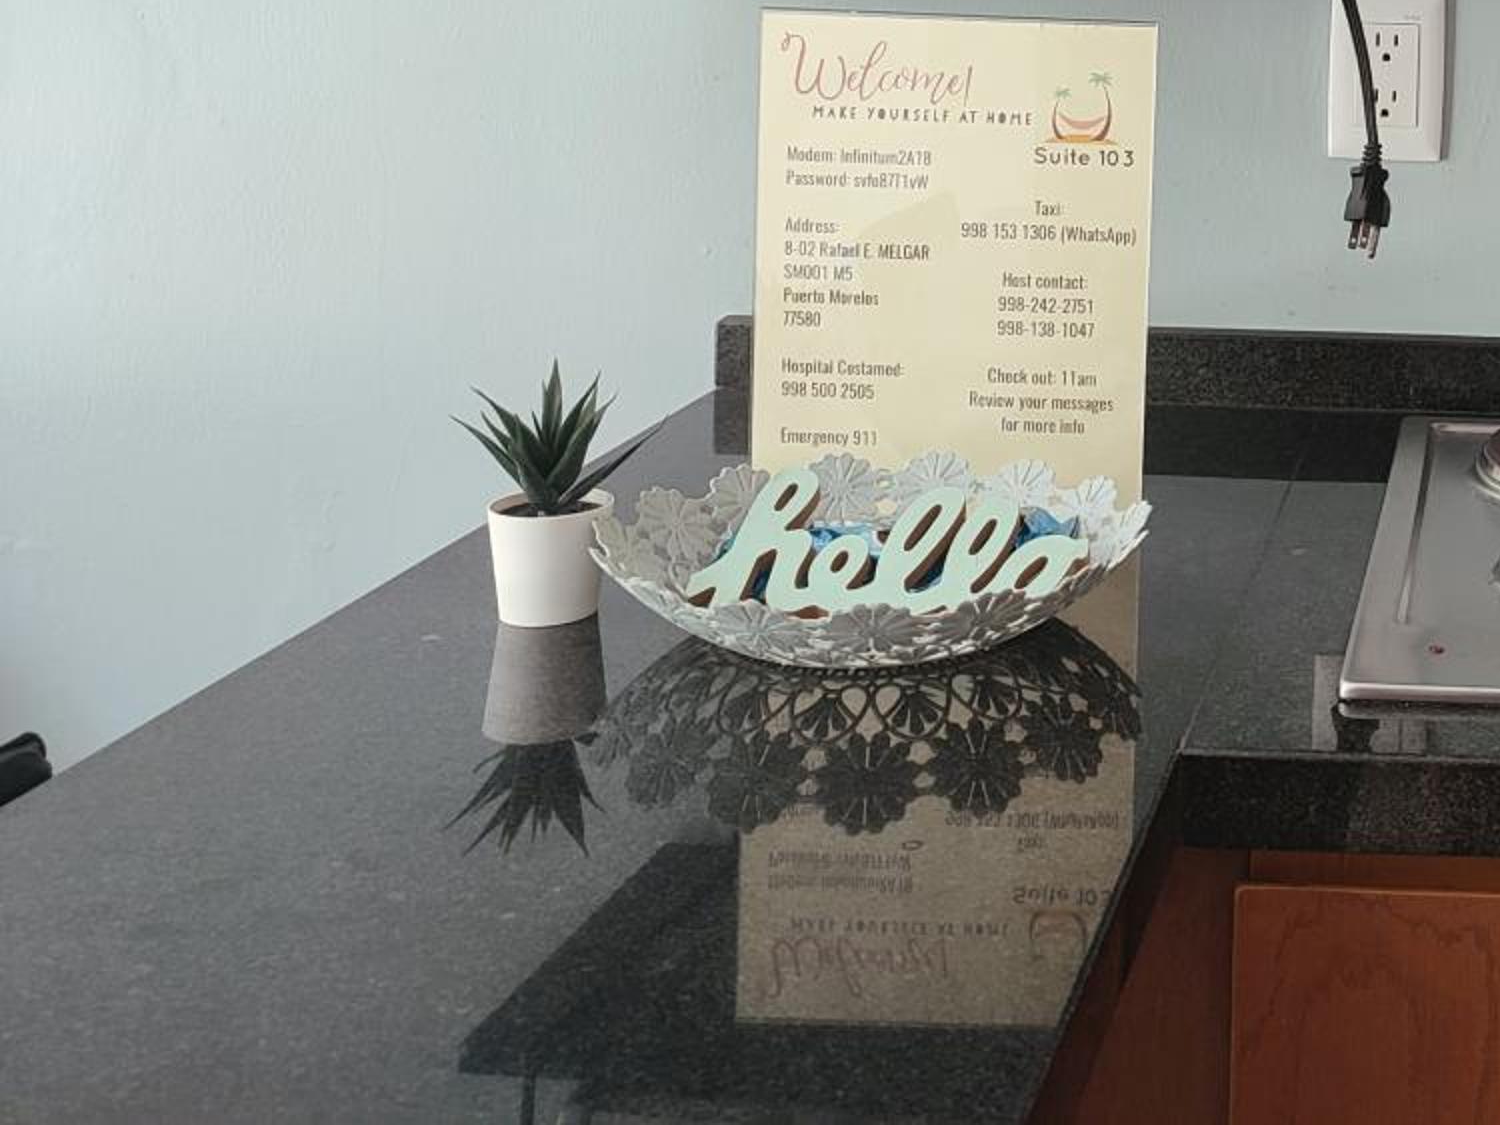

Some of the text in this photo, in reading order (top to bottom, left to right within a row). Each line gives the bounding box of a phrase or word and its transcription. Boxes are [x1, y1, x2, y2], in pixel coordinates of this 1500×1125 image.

[812, 106, 1033, 125] MAKE YOURSELF AT HOME
[1034, 146, 1135, 167] Suite 103
[785, 216, 841, 233] Address:
[961, 222, 1137, 247] 998 153 1306 (WhatsApp)
[877, 243, 930, 260] MELGAR
[833, 265, 853, 281] M5
[1001, 271, 1088, 290] Host contact:
[783, 286, 879, 306] Puerto Morelos
[997, 296, 1094, 314] 998-242-2751
[783, 310, 821, 327] 77580
[997, 320, 1095, 338] 998-138-1047
[781, 357, 833, 376] Hospital
[987, 367, 1097, 387] Check out: 11am
[781, 380, 875, 399] 998 500 2505
[969, 390, 1115, 414] Review your messages
[1001, 416, 1085, 435] for more info
[780, 426, 877, 446] Emergency 911
